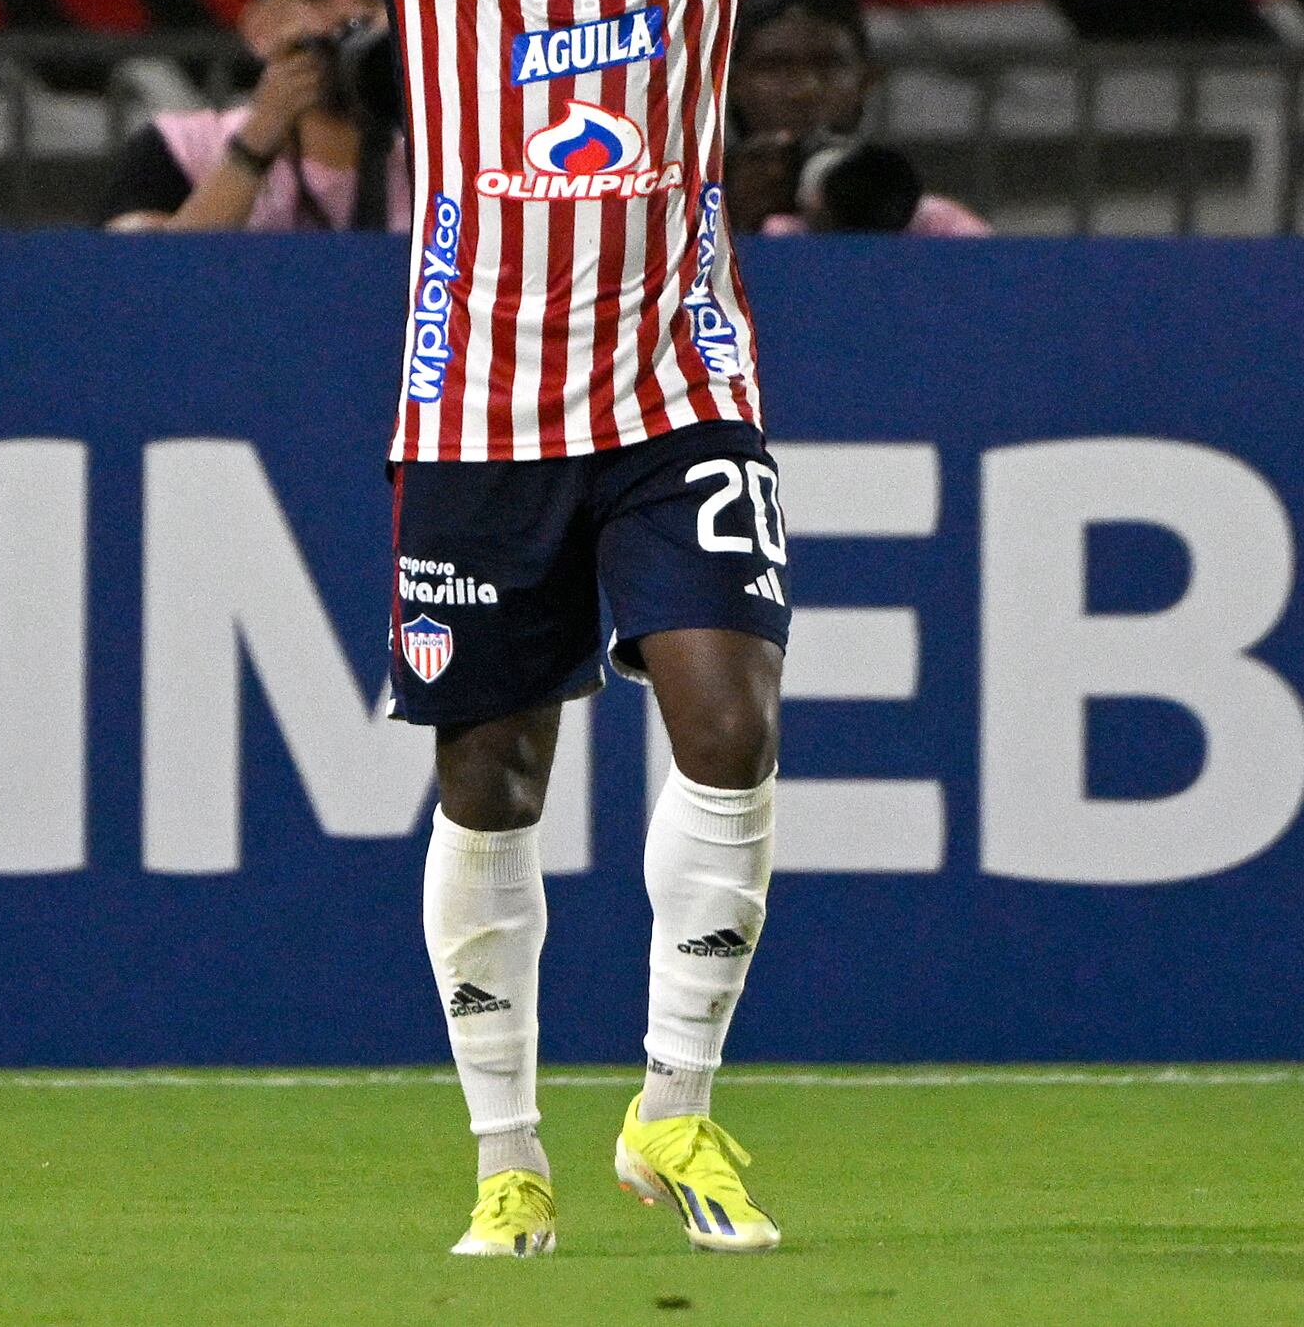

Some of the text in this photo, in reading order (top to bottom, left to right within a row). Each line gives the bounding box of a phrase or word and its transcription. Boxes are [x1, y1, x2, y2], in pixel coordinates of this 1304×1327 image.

[517, 12, 656, 81] AGUILA
[477, 164, 683, 199] OLIMPICA
[685, 459, 787, 566] 20
